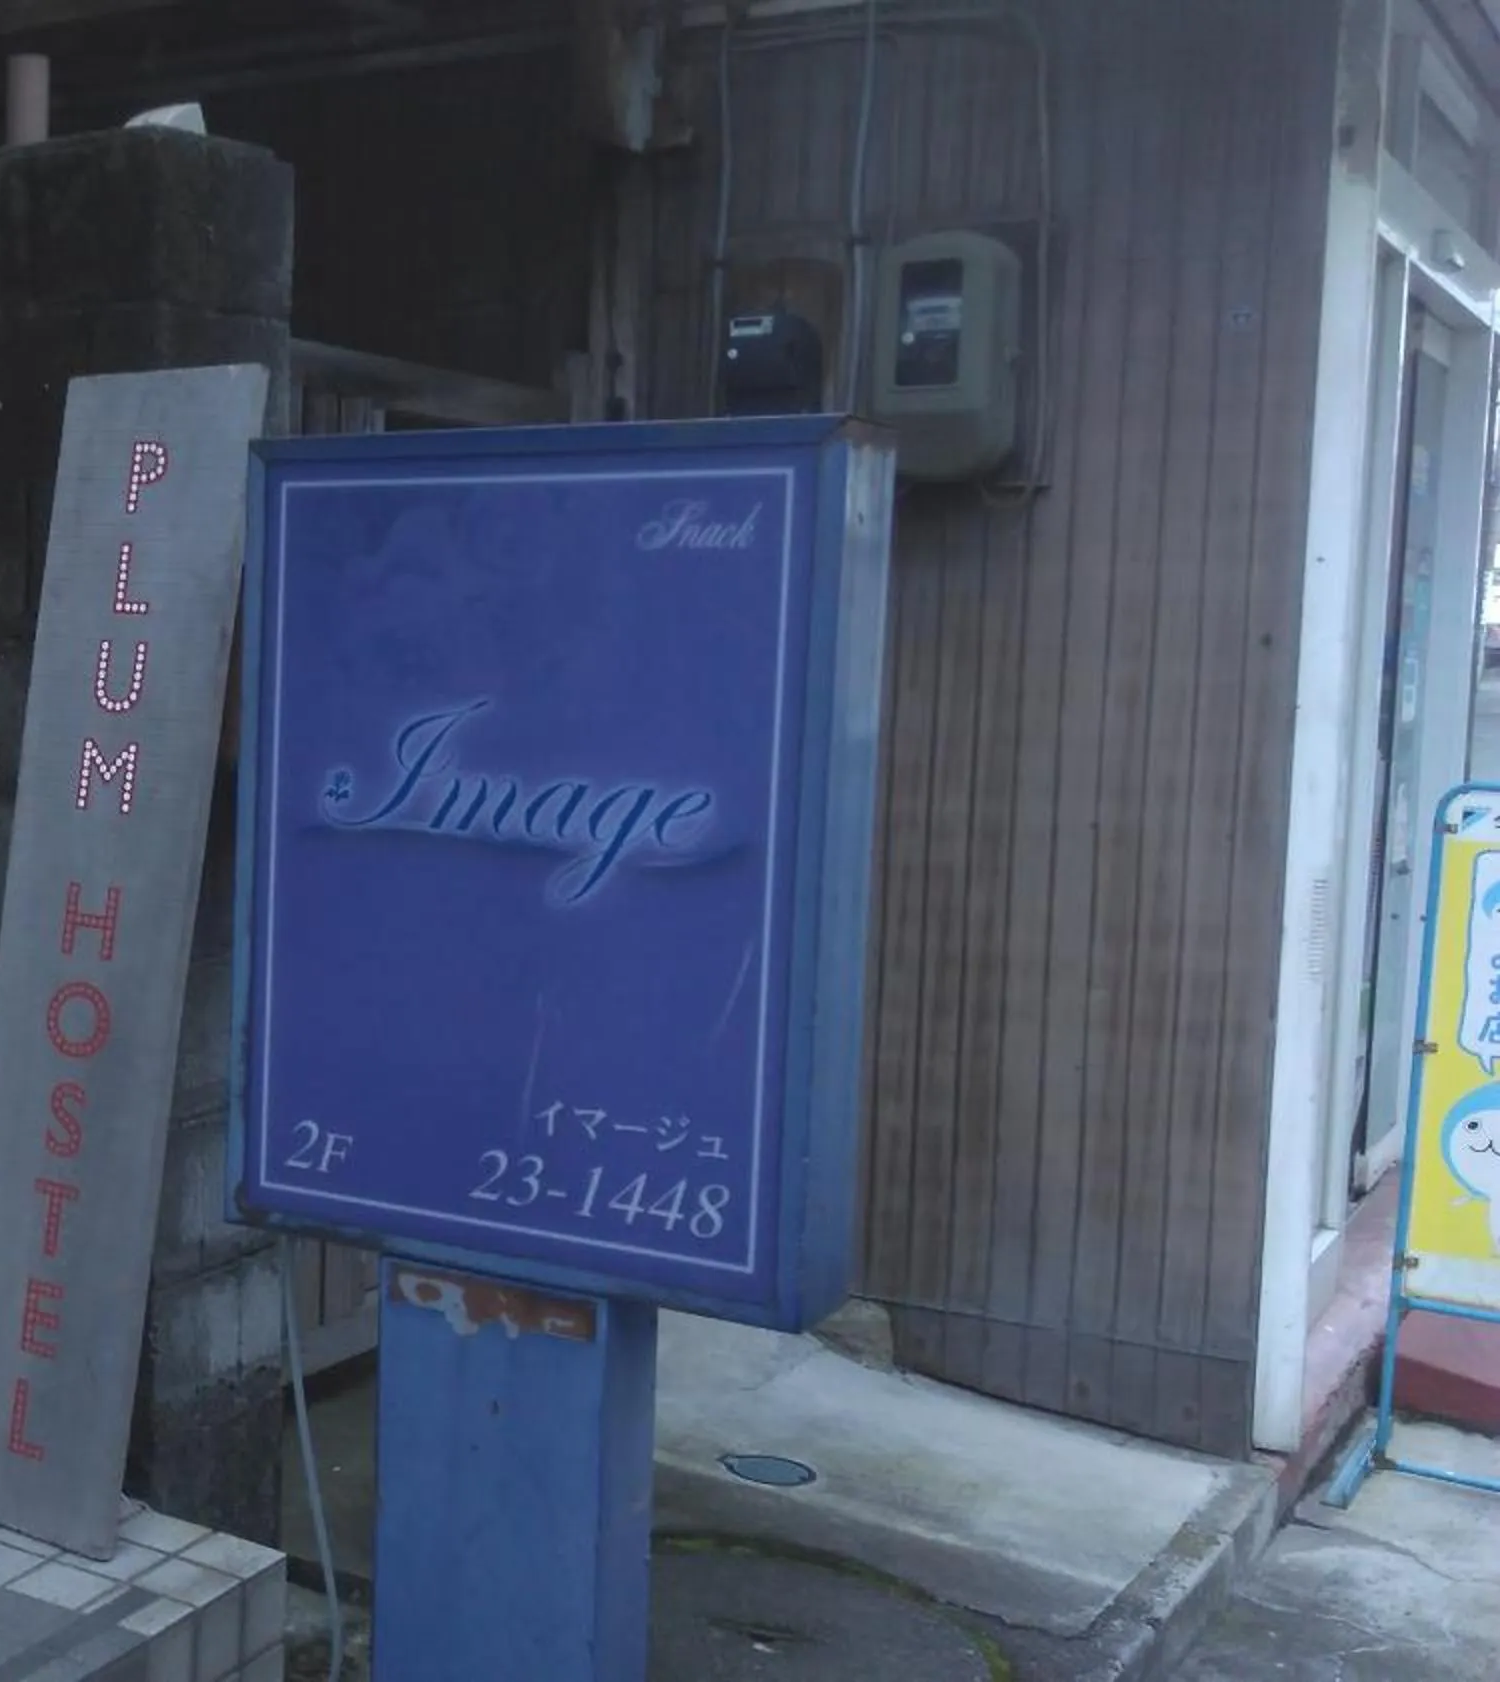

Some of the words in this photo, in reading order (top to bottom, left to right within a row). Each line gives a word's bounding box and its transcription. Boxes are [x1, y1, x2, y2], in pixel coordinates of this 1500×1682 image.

[636, 498, 763, 552] Snack
[75, 440, 169, 815] PLUM
[325, 700, 712, 902] Image
[6, 880, 122, 1462] HOSTEL
[284, 1119, 354, 1175] 2F
[534, 1100, 730, 1161] イマージュ
[468, 1148, 731, 1239] 23-1448
